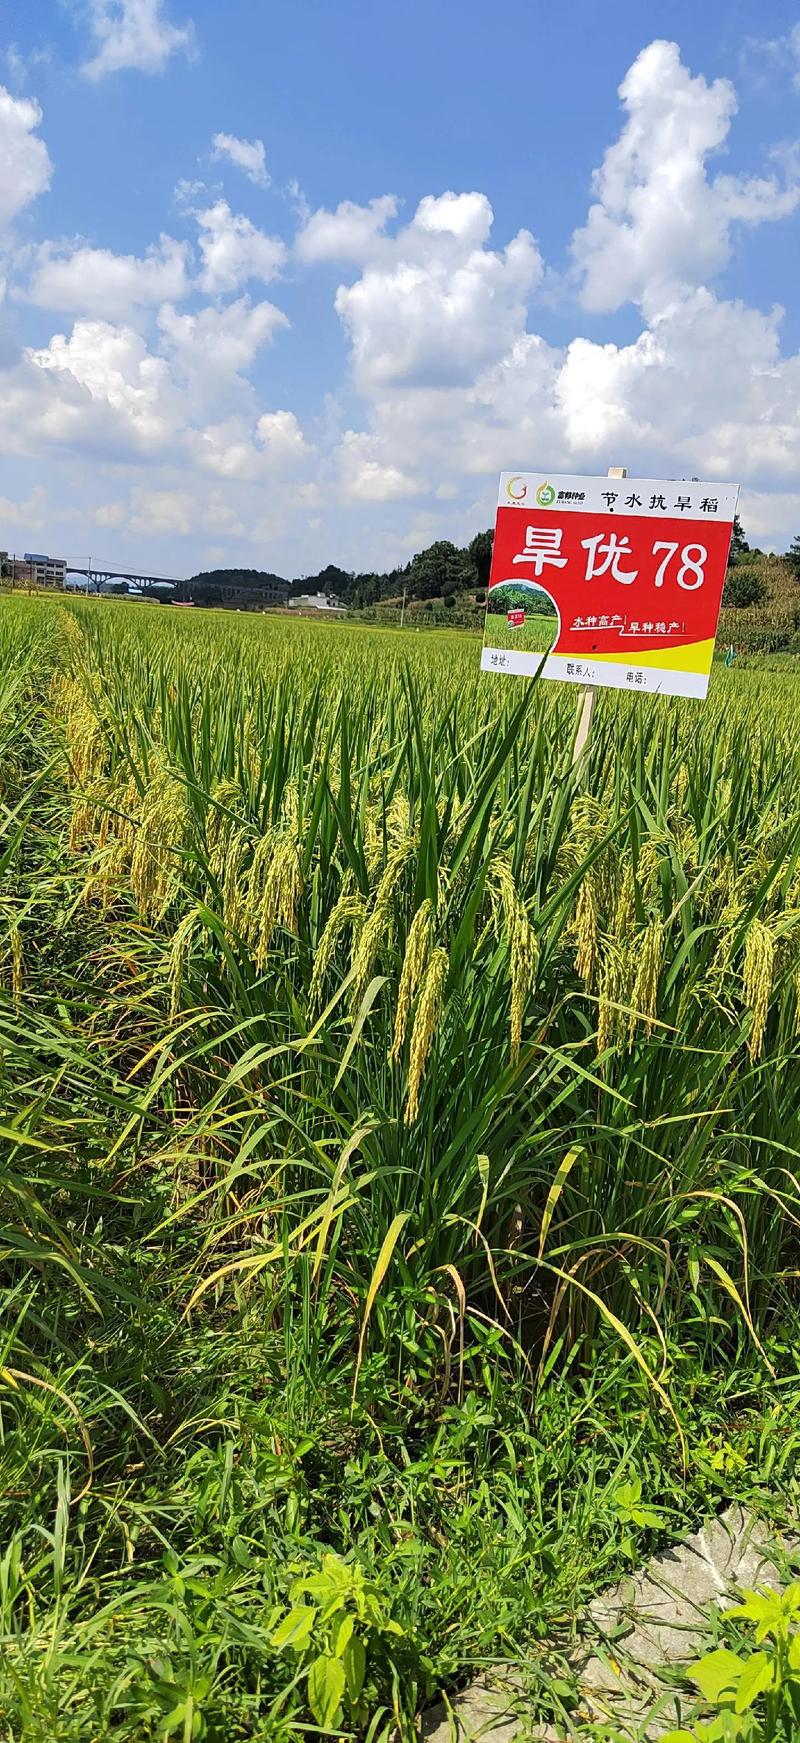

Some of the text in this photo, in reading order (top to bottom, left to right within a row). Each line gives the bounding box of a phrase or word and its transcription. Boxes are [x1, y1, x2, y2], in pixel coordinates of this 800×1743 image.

[601, 492, 719, 513] 节水抗旱稻
[566, 662, 595, 678] 联系人：
[625, 671, 647, 685] 电话：
